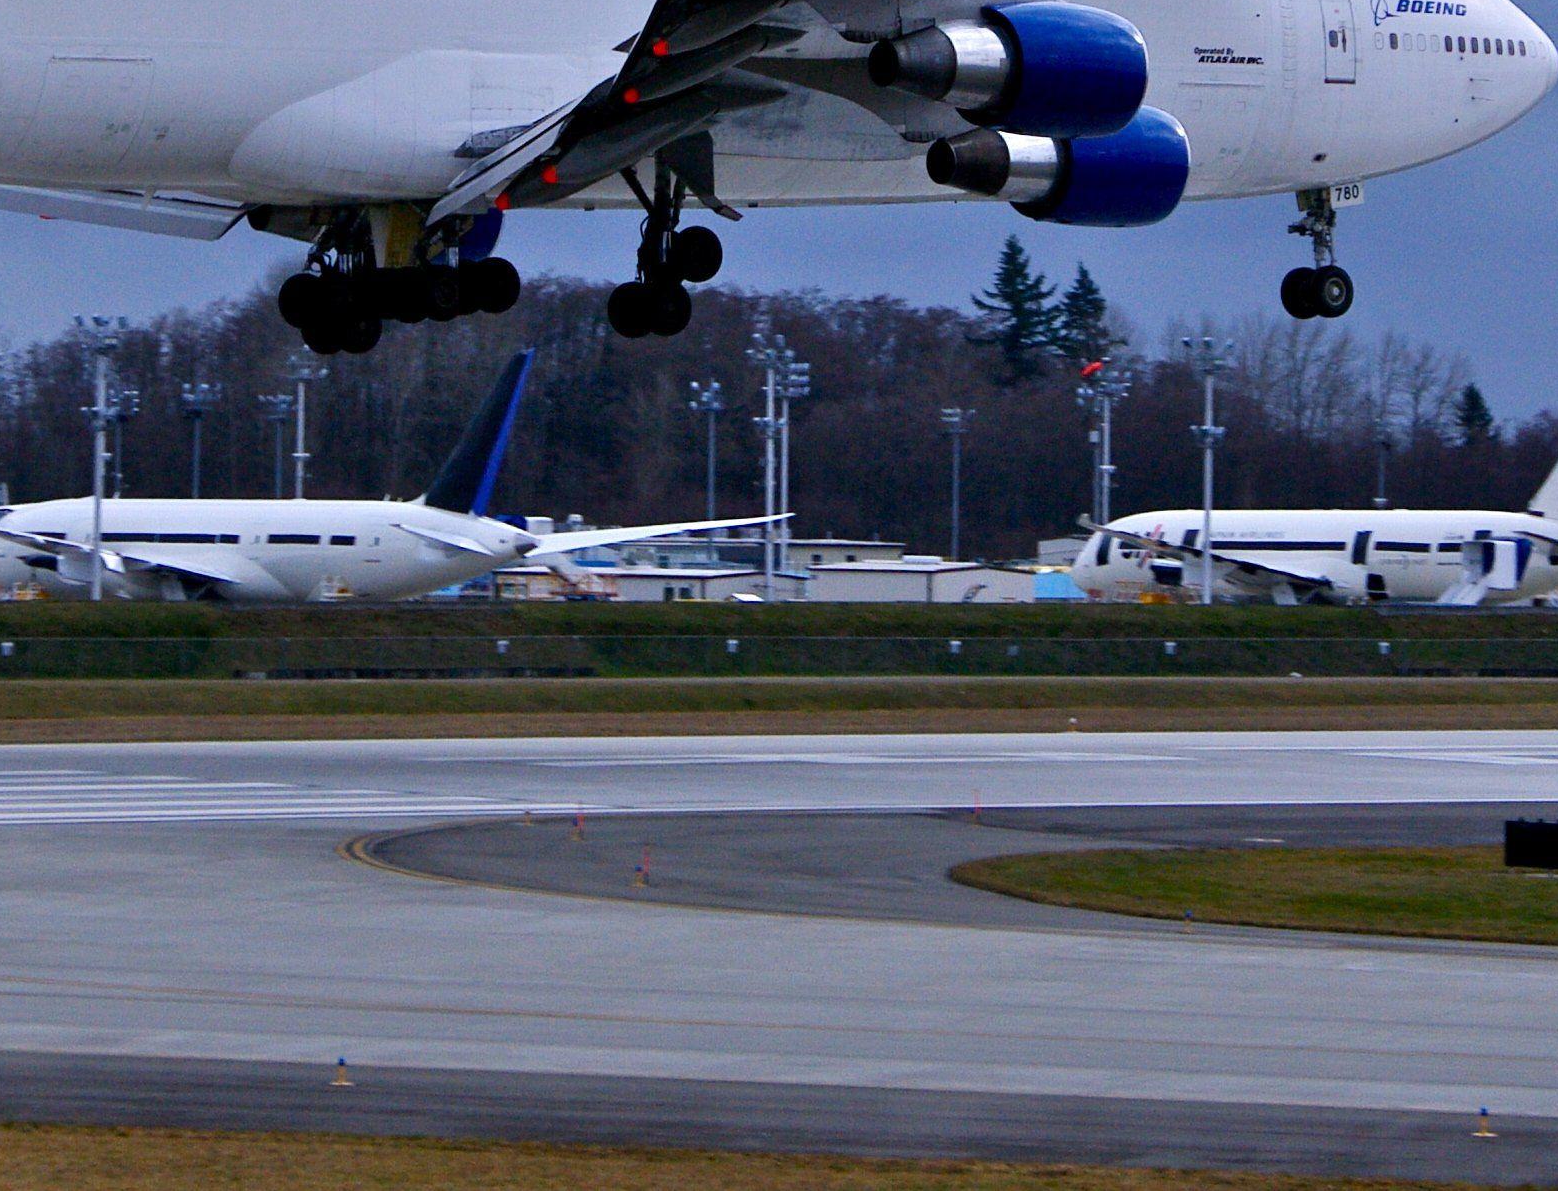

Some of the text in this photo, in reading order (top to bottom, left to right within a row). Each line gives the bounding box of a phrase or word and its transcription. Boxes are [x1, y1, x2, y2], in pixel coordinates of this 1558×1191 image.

[1193, 46, 1225, 56] Operated
[1198, 55, 1229, 64] ATLAS
[1229, 56, 1246, 65] AIR
[1334, 183, 1360, 202] 780
